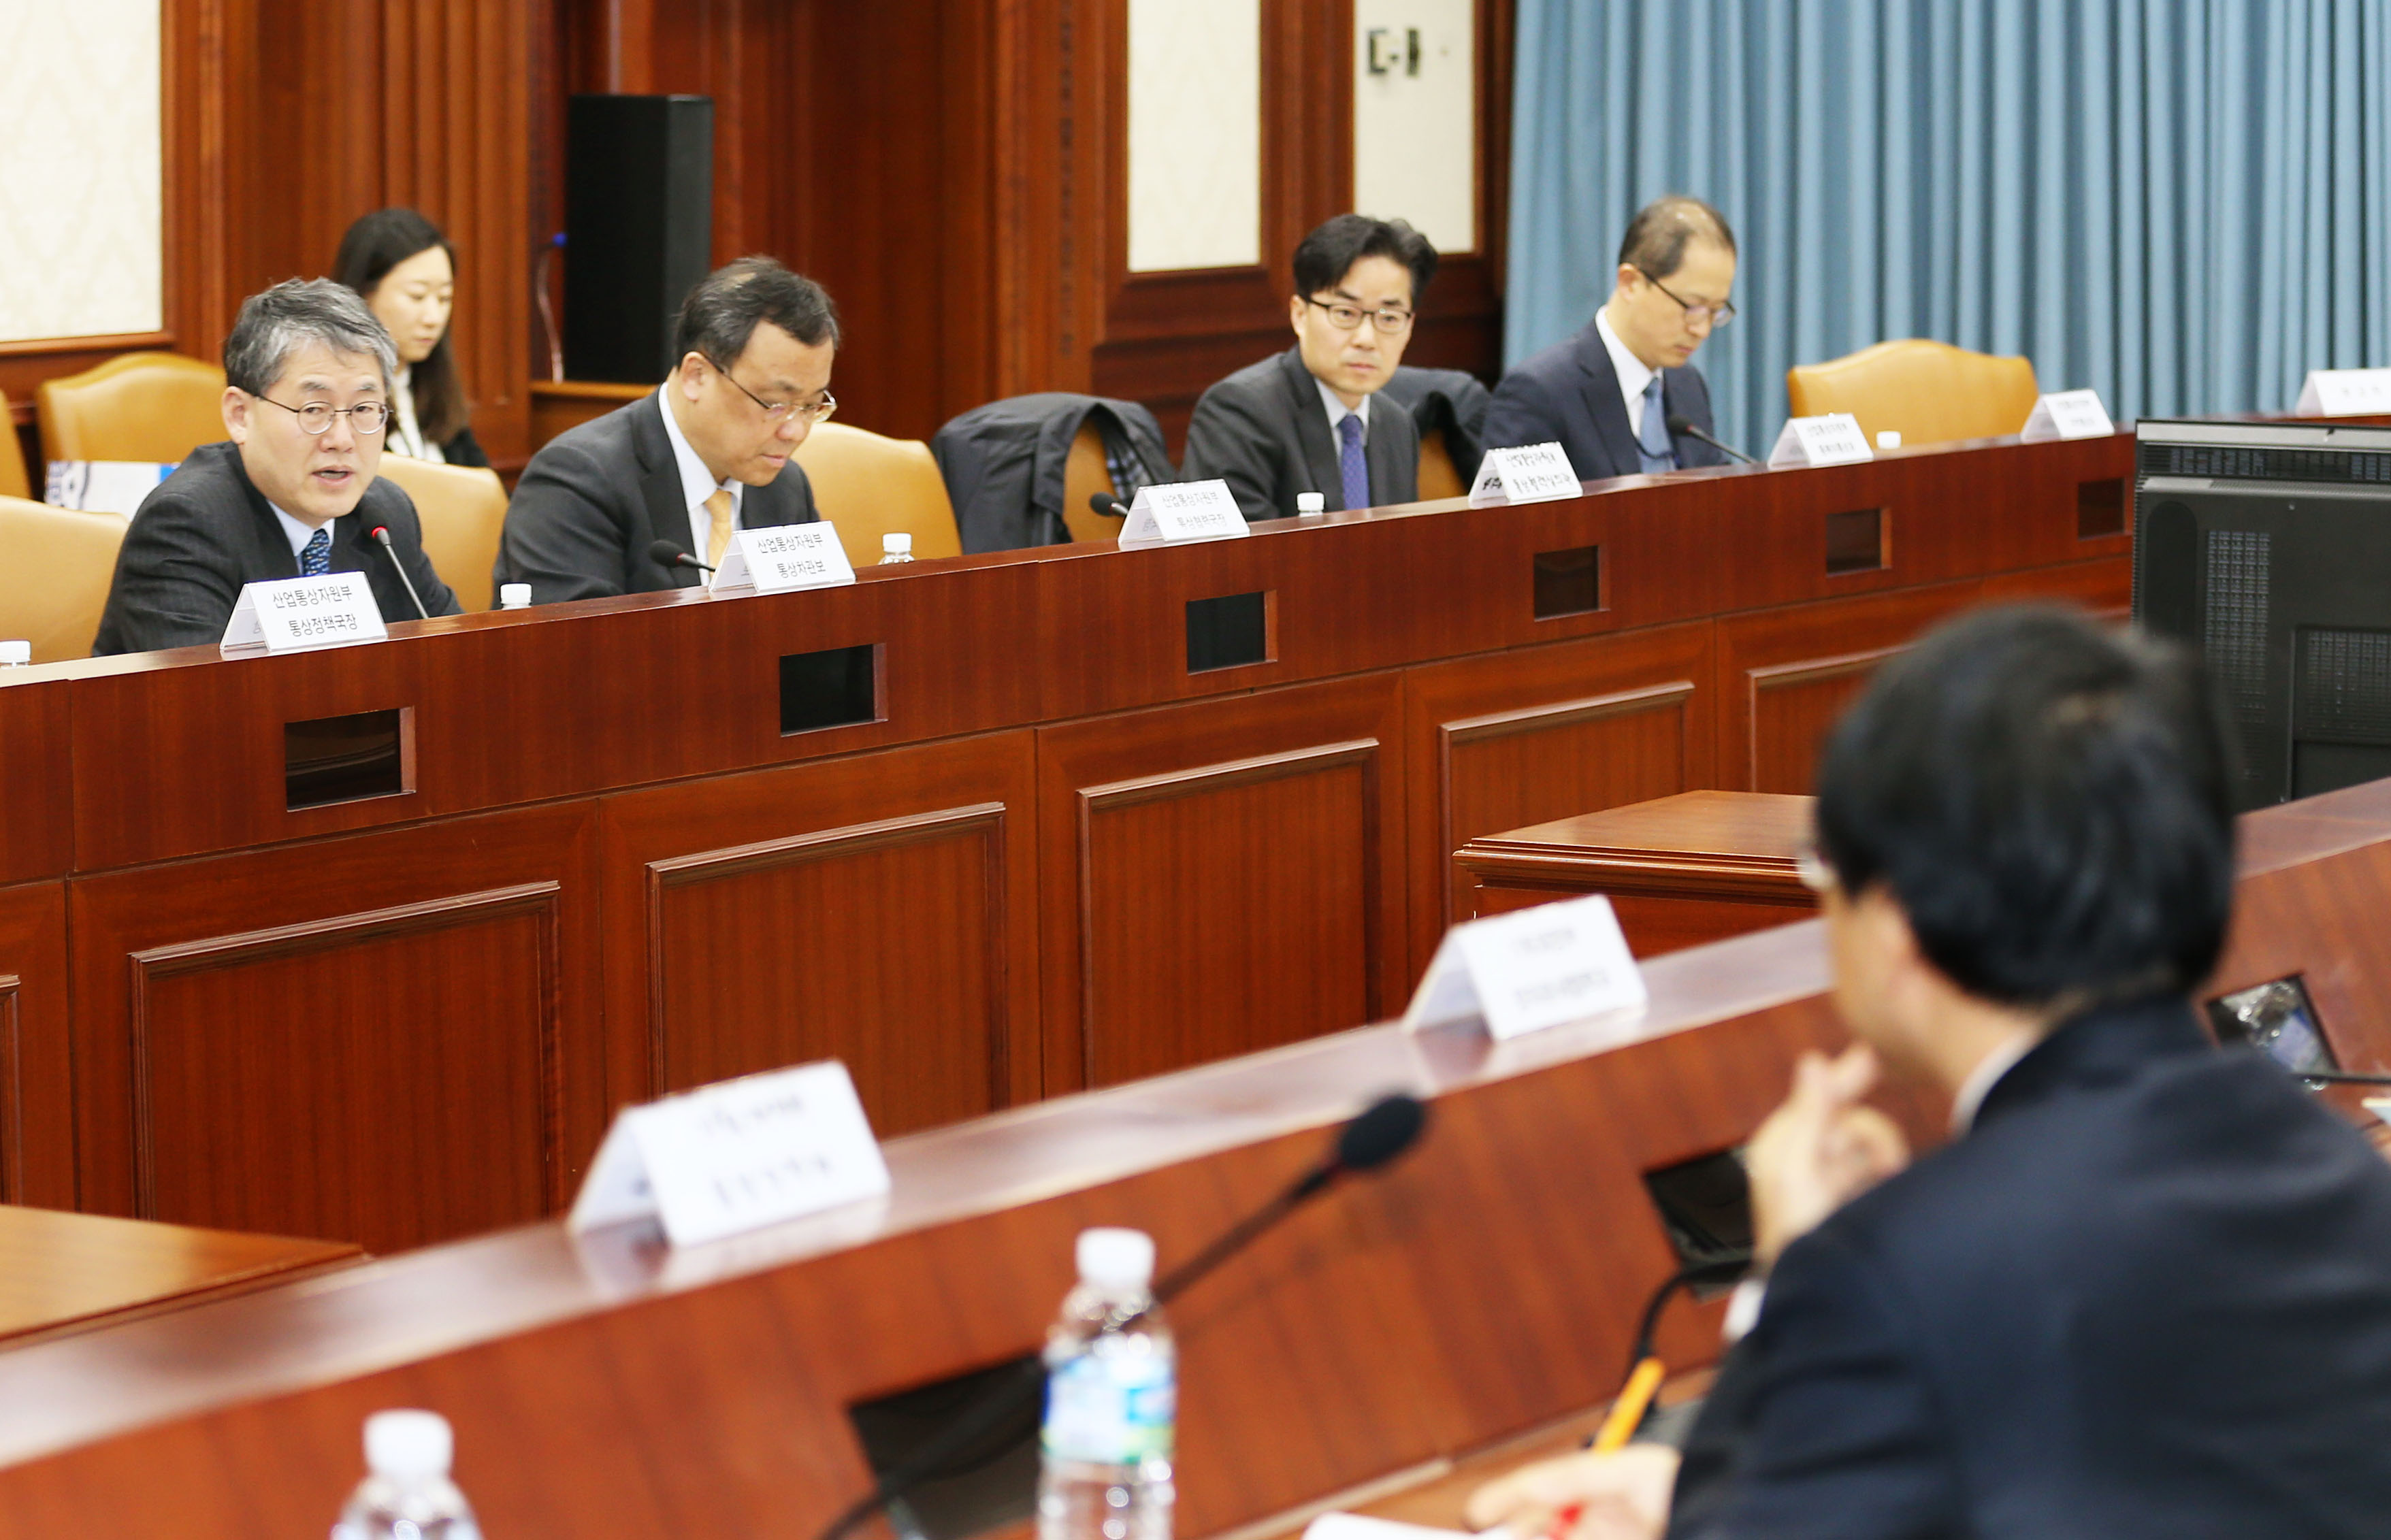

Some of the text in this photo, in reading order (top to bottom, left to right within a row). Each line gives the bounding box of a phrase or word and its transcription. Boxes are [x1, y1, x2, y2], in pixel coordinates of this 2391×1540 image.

[758, 534, 824, 554] 산업통상자원부
[777, 559, 826, 578] 통상차관보
[273, 585, 353, 609] 산업통상자원부
[289, 612, 358, 637] 통상정책국장
